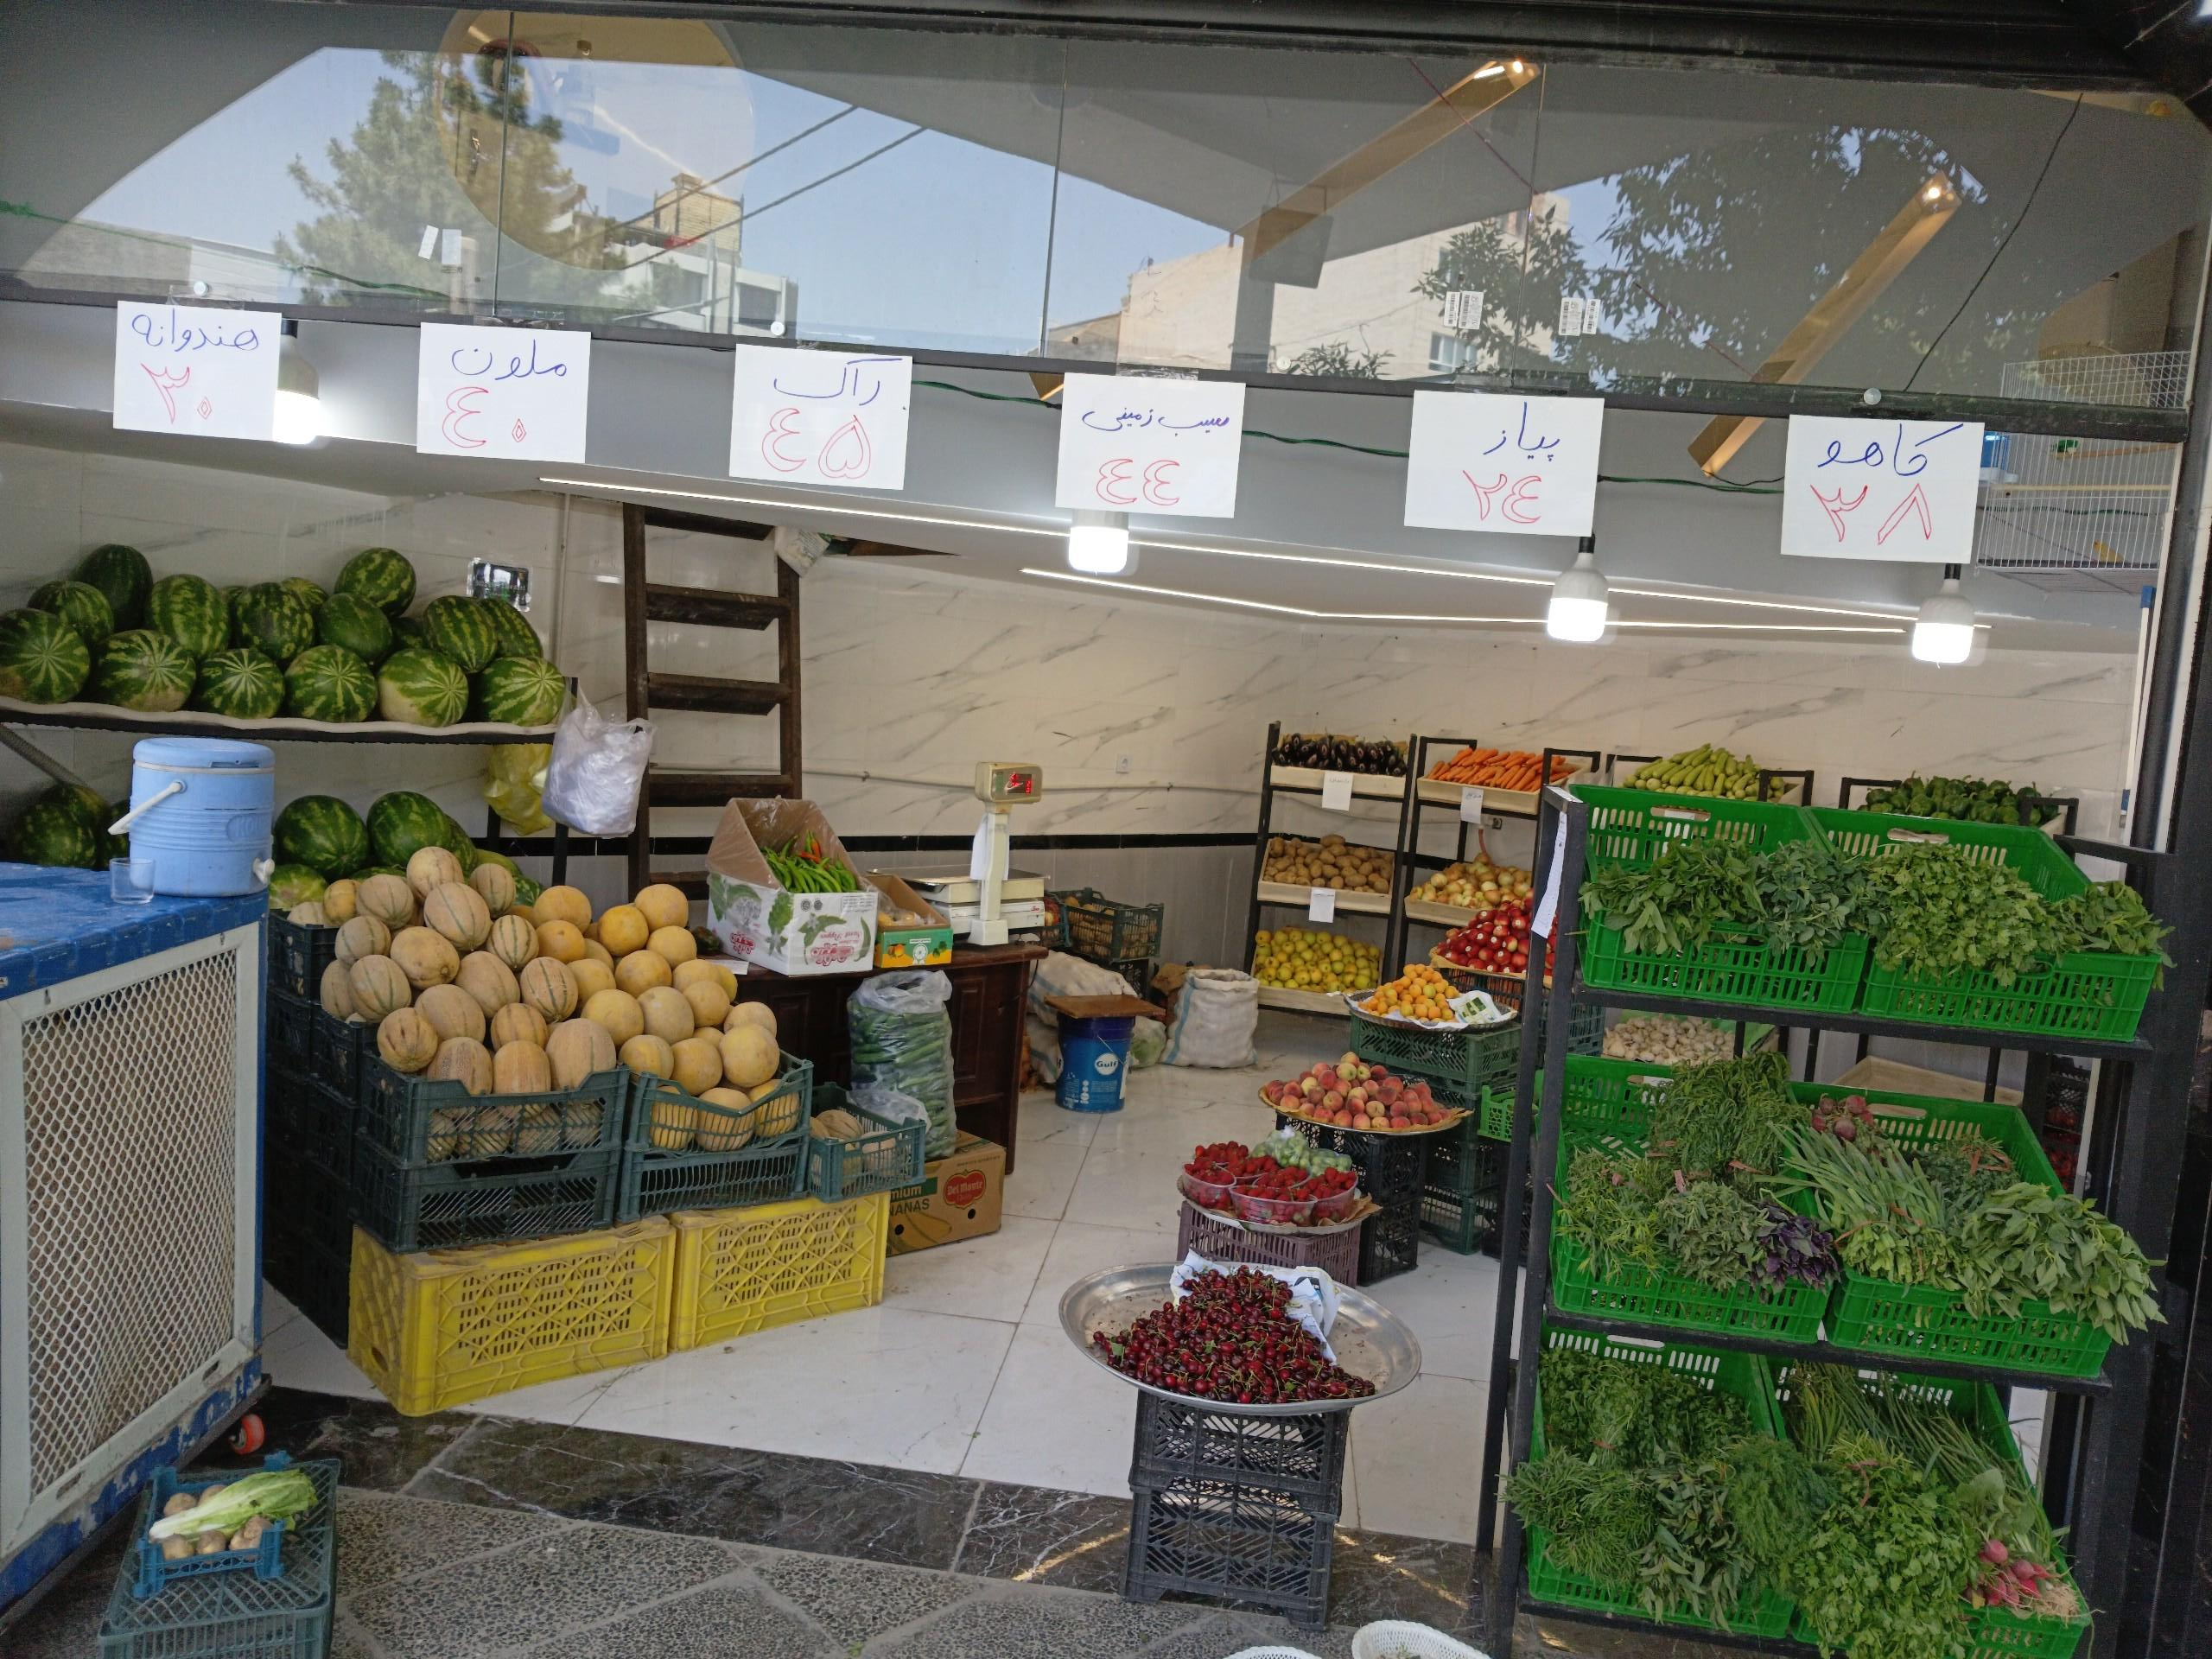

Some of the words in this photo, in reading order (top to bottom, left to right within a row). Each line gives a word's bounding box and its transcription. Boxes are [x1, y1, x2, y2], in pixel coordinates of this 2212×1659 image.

[131, 308, 259, 353] هندوانه
[451, 339, 568, 381] ملون
[1081, 407, 1154, 432] زمینی
[1157, 416, 1230, 437] سیب
[1482, 401, 1561, 462] پیاز
[1816, 423, 1965, 477] کاهو
[1809, 482, 1933, 546] ۳۸
[1096, 1060, 1118, 1069] Gulf
[891, 1185, 921, 1198] mium
